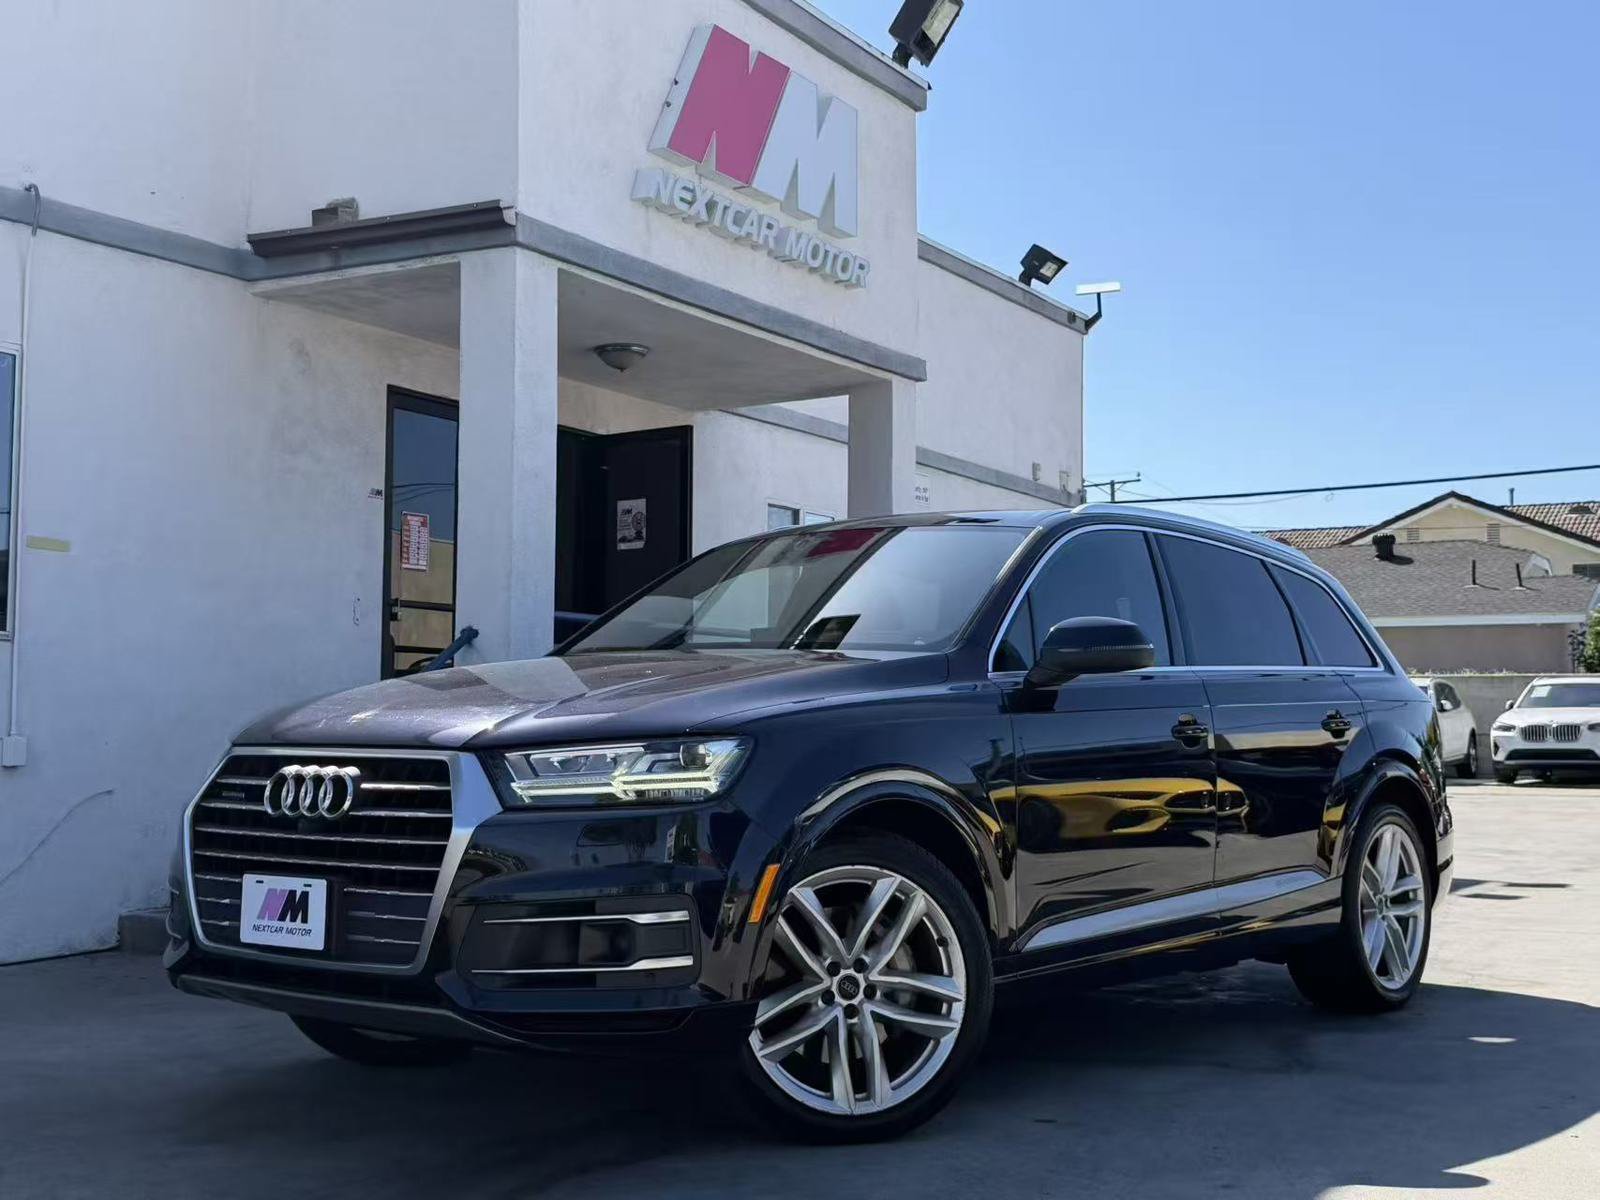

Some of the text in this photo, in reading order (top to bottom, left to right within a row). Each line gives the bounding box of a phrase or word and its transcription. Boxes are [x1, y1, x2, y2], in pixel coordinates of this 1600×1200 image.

[660, 24, 858, 237] NM
[634, 168, 871, 288] NEXTCAR MOTOR
[252, 924, 312, 937] NEXTCAR MOTOR
[257, 888, 309, 924] NM
